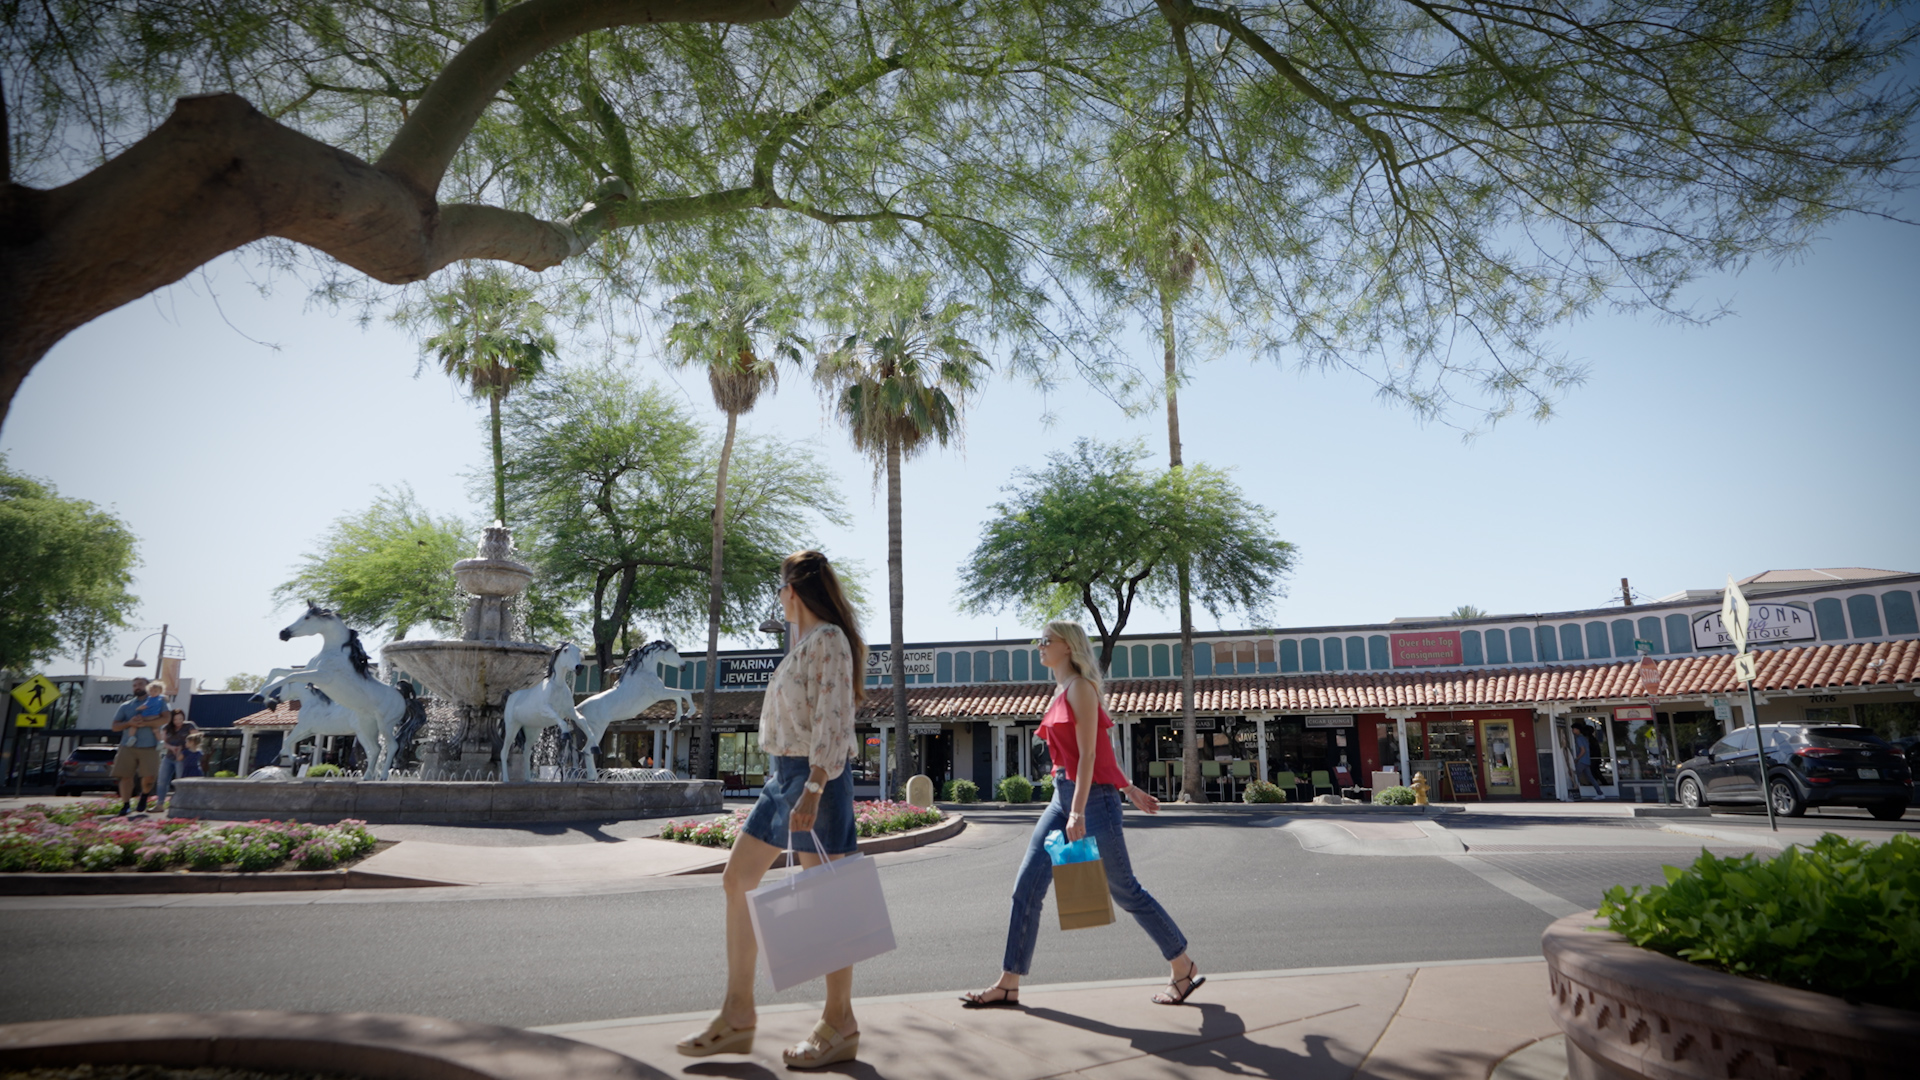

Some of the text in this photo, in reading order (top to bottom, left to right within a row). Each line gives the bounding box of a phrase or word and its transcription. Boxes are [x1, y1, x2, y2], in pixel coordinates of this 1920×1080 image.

[1703, 606, 1801, 632] ARONA
[1717, 627, 1790, 643] BOTIQUE
[1398, 636, 1453, 648] Over the Top
[1400, 650, 1454, 662] Consignment
[730, 659, 775, 670] MARINA
[884, 663, 930, 674] VYARDS
[1641, 668, 1659, 683] STOP
[1808, 695, 1837, 703] 7076
[1575, 705, 1598, 713] 7074
[1238, 732, 1275, 742] JAVENA
